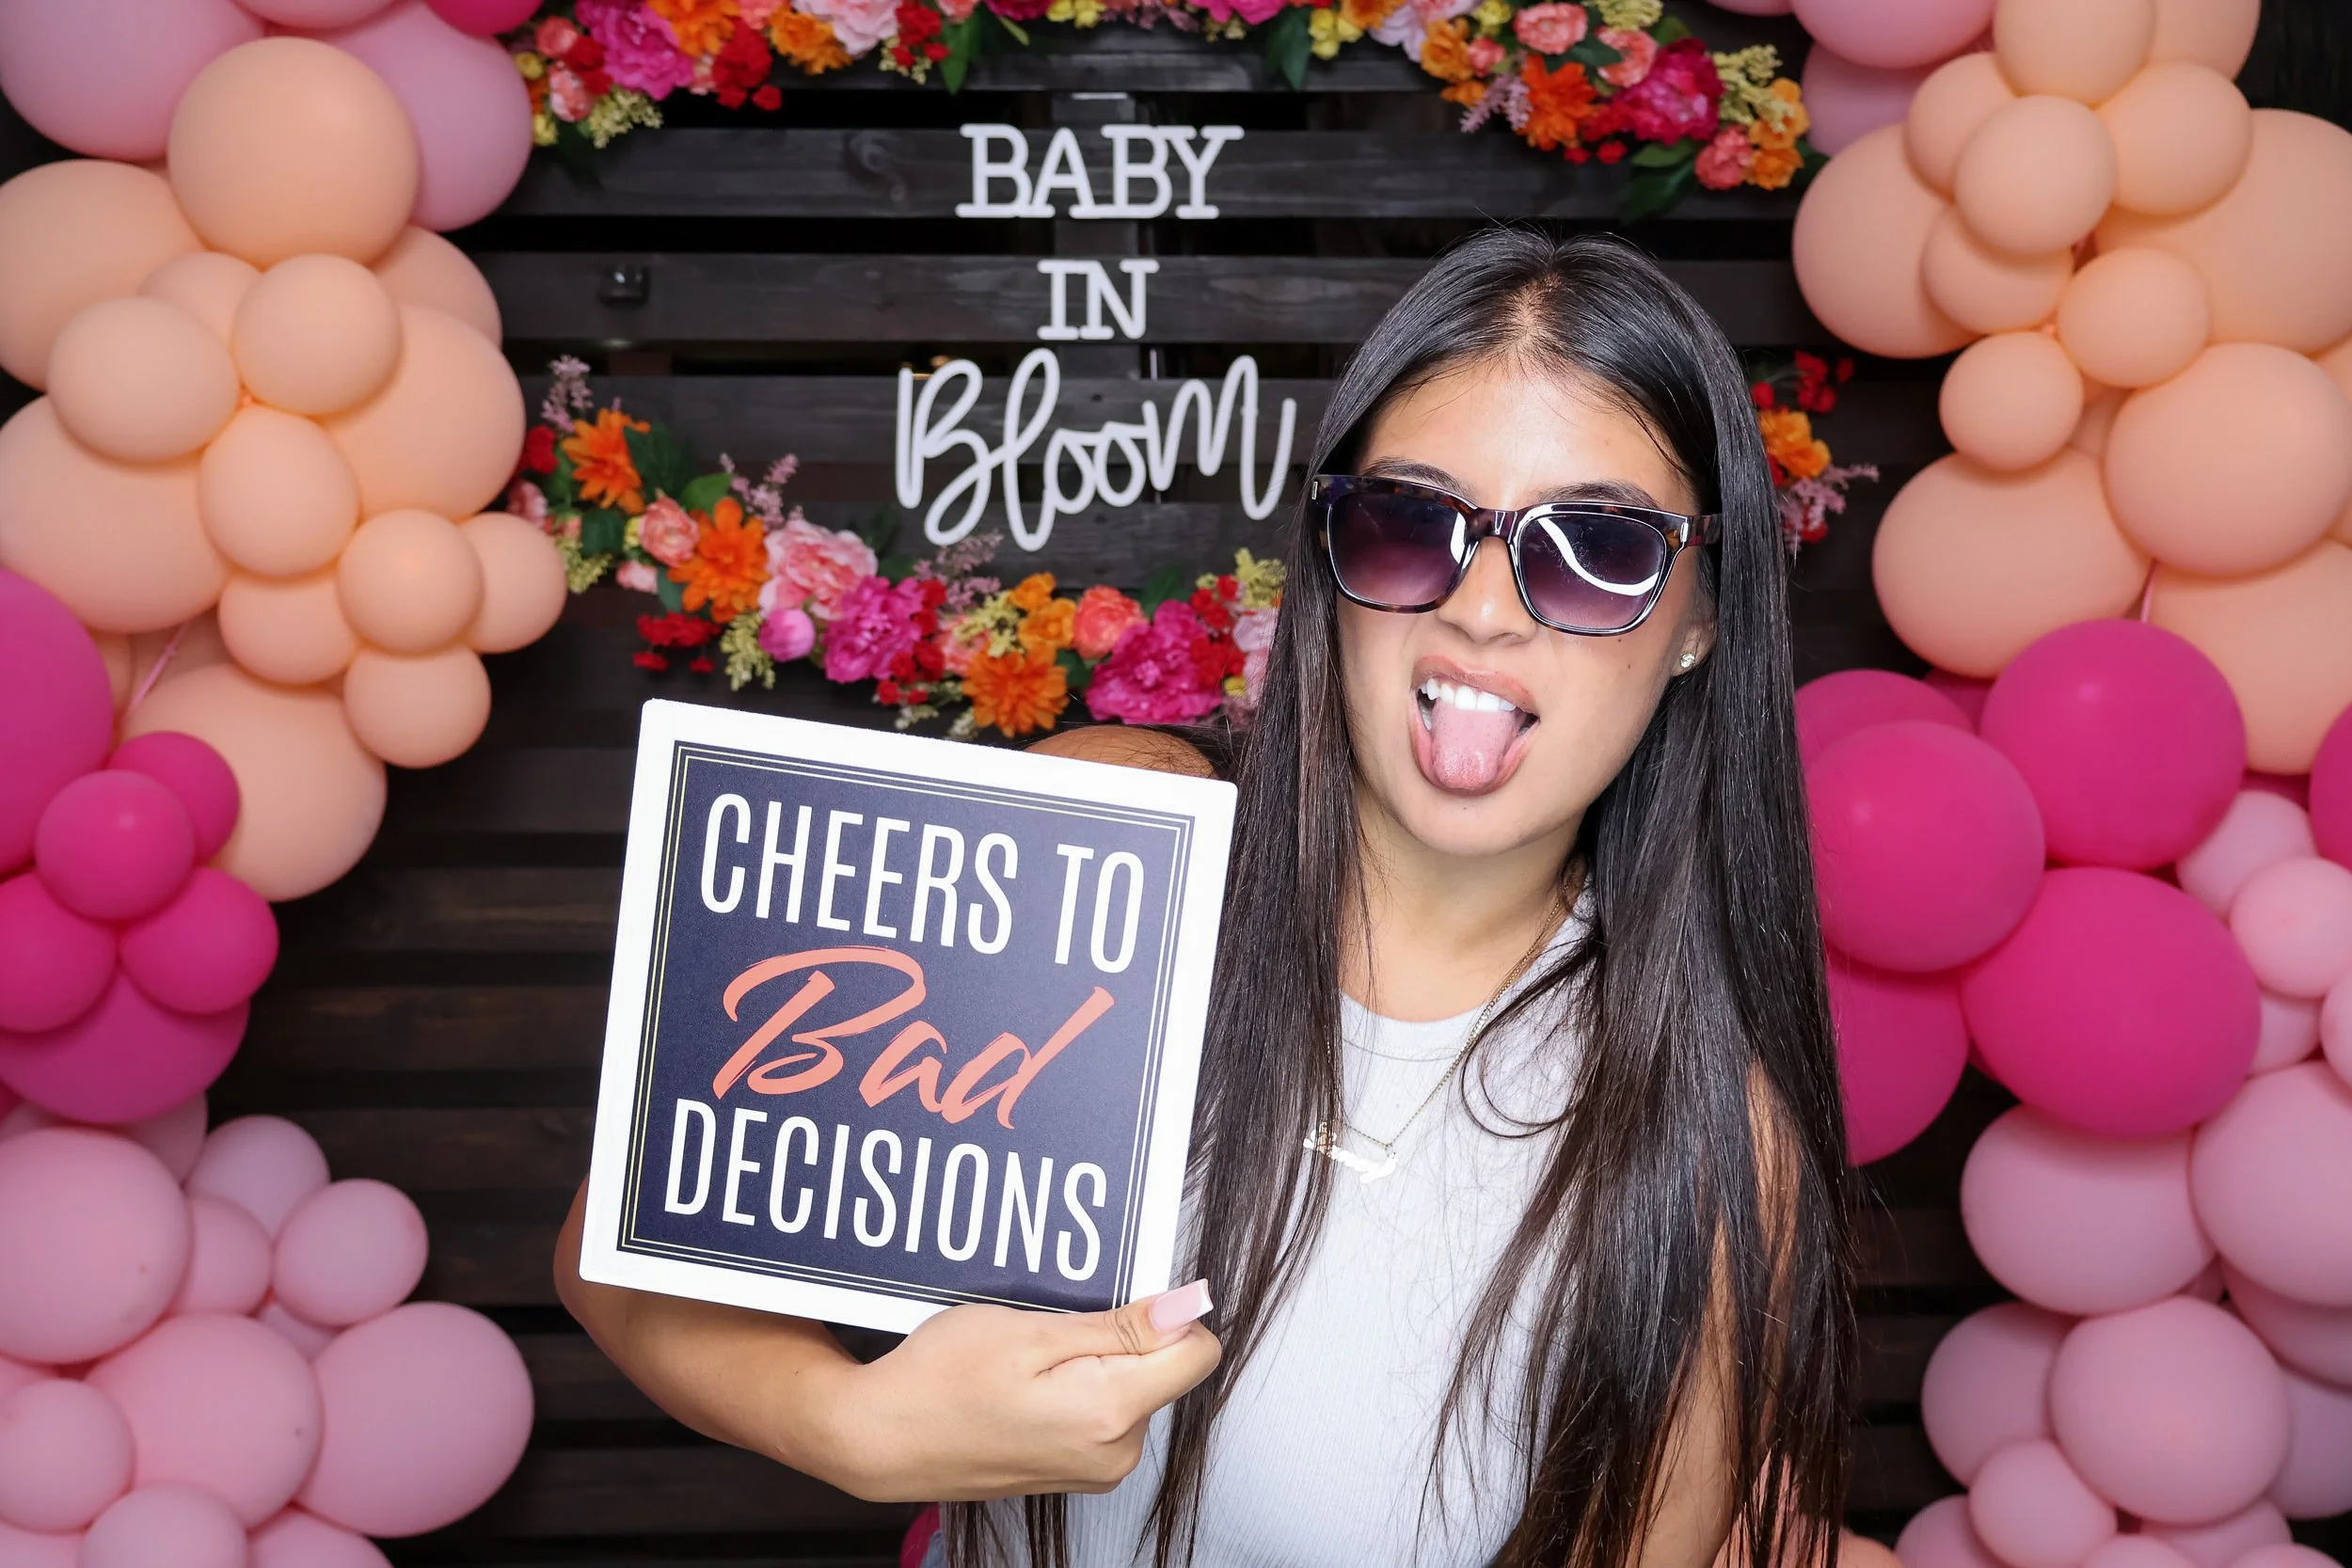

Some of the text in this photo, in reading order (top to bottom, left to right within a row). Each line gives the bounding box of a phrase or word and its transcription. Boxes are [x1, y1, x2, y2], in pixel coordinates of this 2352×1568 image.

[955, 123, 1245, 220] BABY
[1037, 259, 1160, 341] IN
[700, 793, 1145, 974] CHEERS TO
[712, 944, 1115, 1130] Bad
[663, 1098, 1108, 1281] DECISIONS
